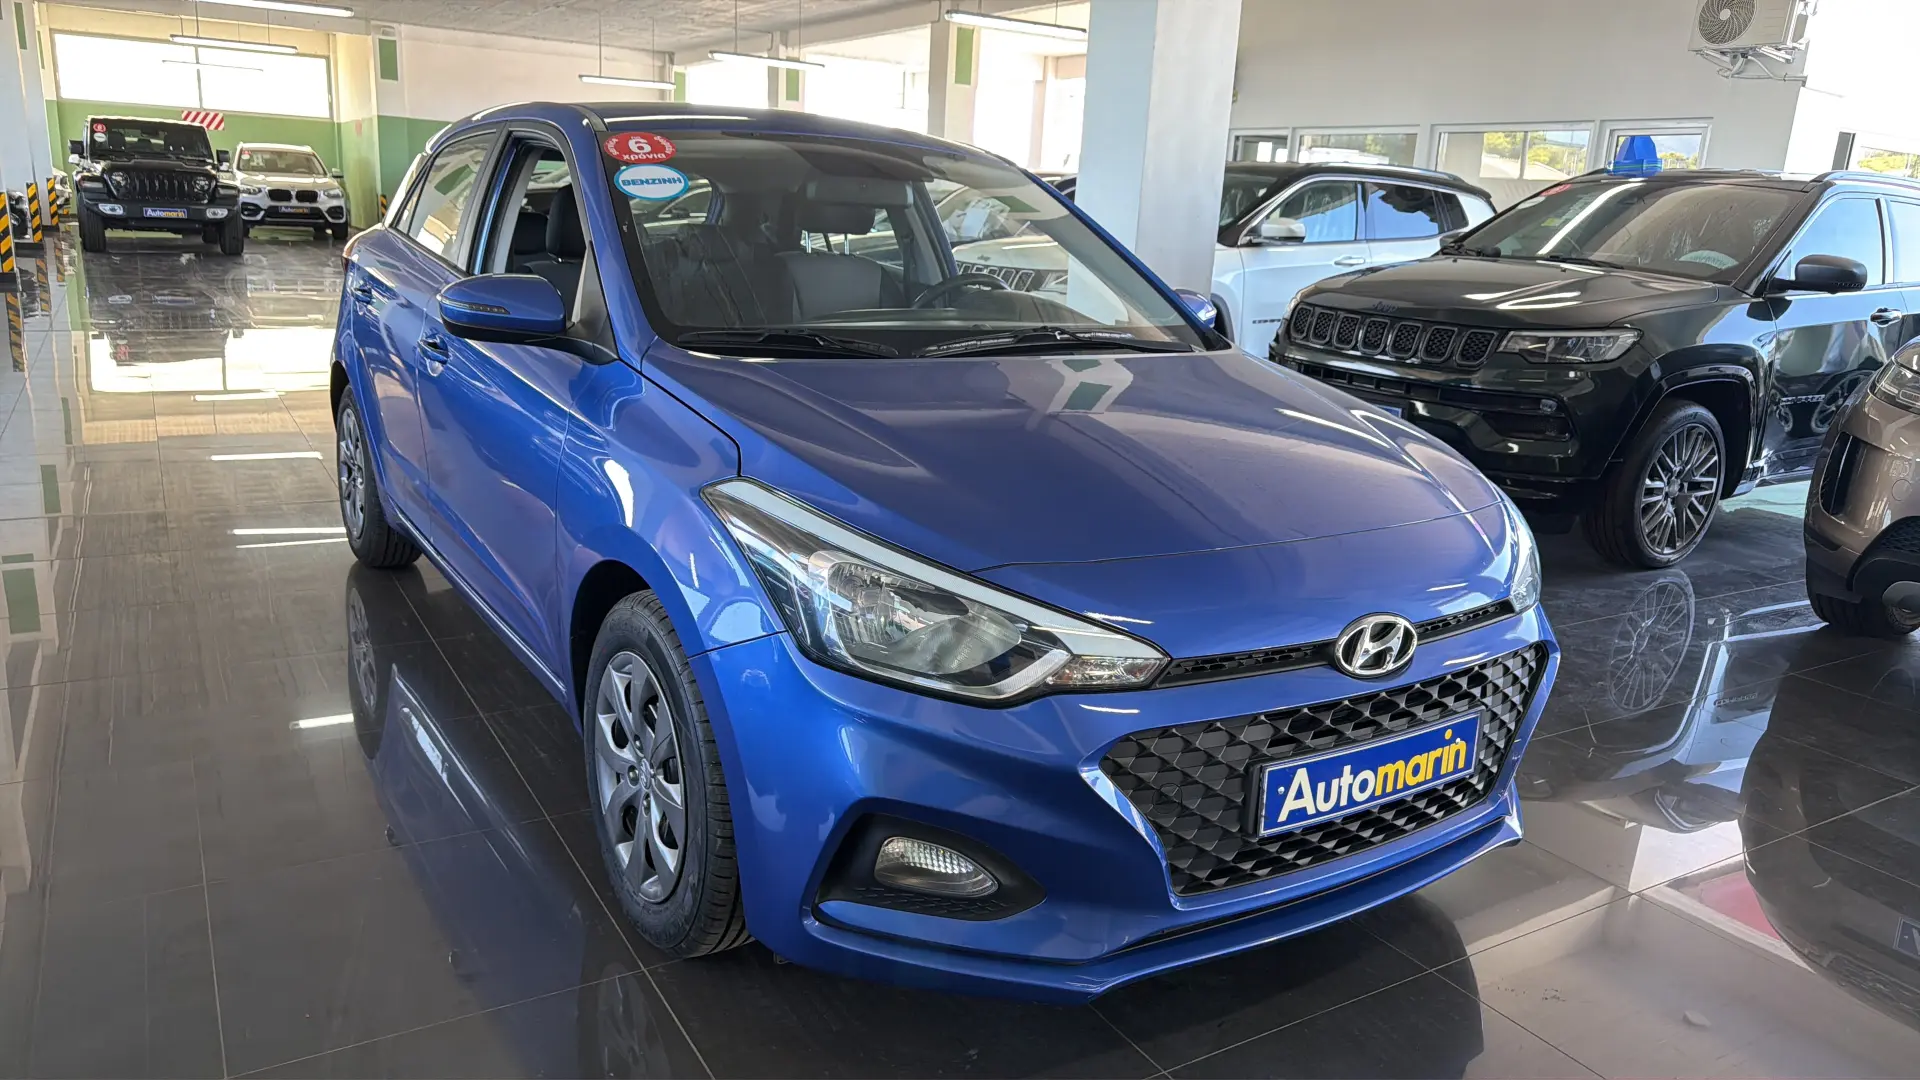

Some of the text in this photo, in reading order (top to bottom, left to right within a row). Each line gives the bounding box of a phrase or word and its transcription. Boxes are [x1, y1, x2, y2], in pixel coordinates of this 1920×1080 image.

[628, 138, 652, 154] 6
[146, 208, 185, 218] Automarin
[1276, 728, 1468, 823] Automarin
